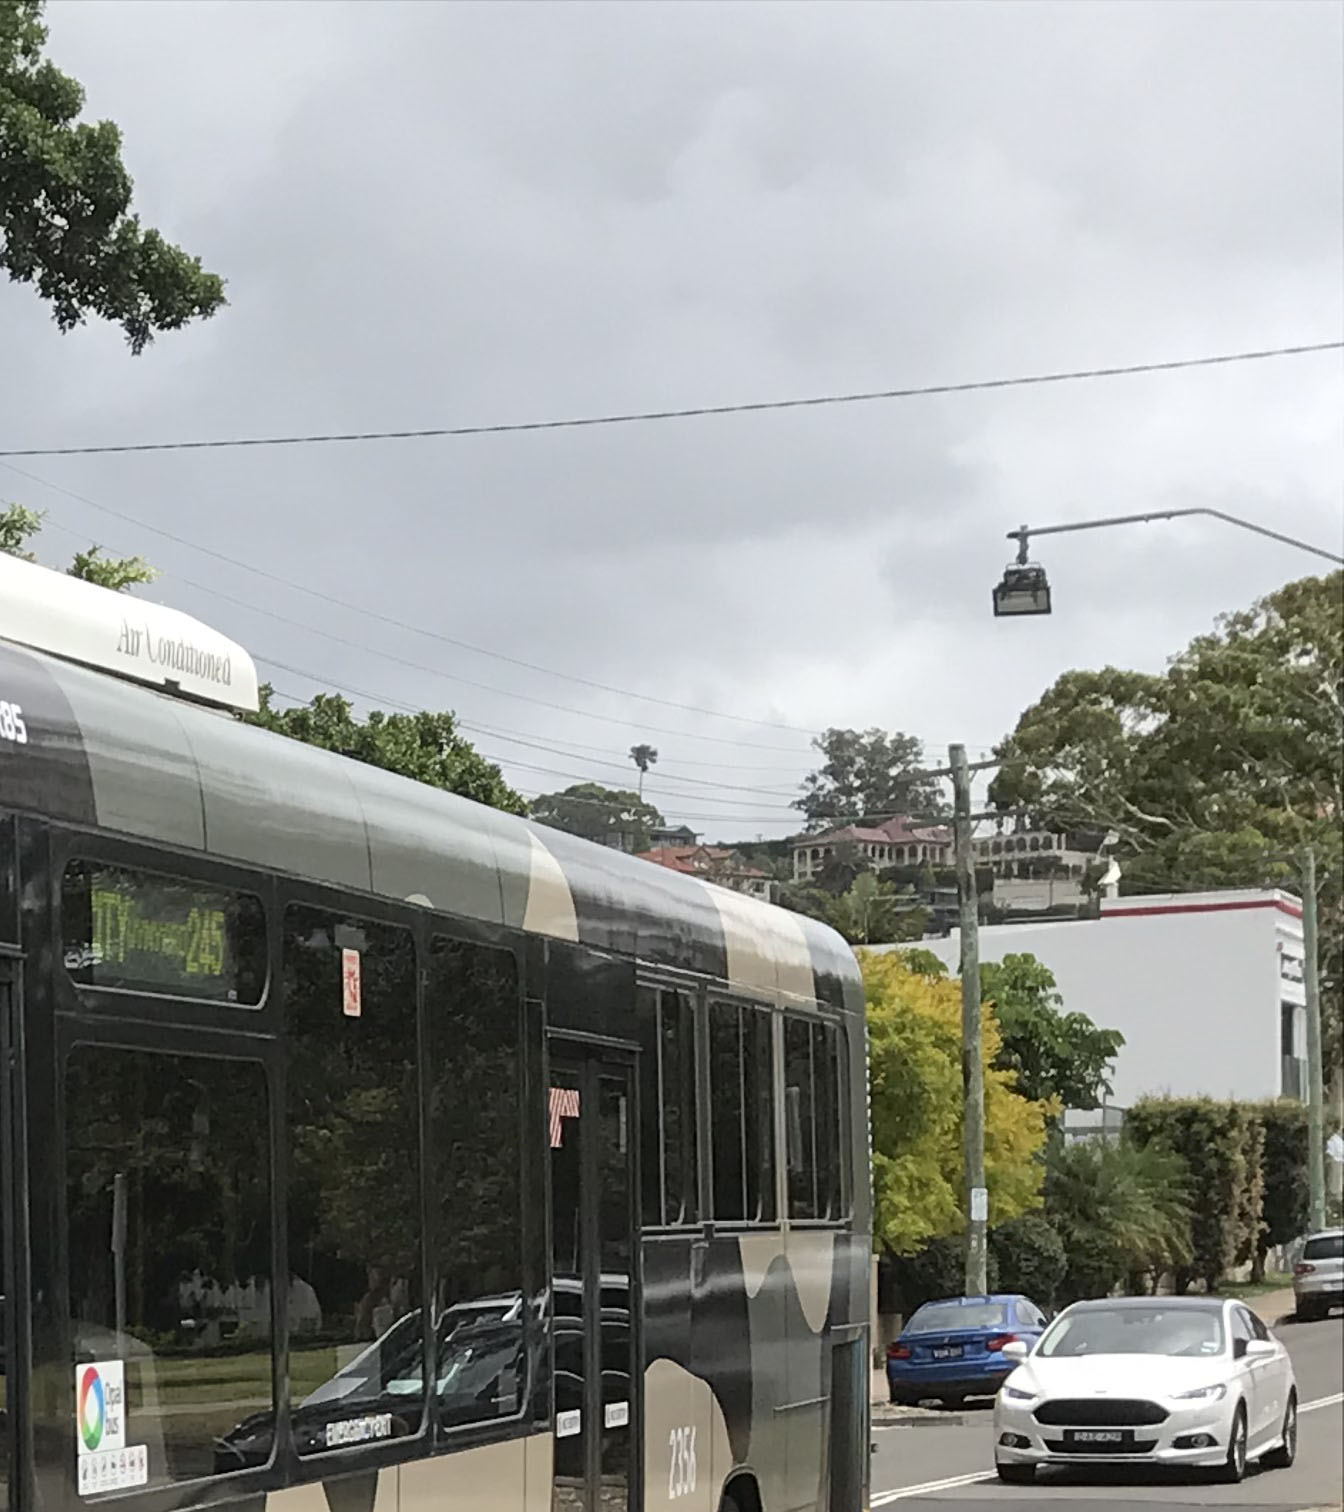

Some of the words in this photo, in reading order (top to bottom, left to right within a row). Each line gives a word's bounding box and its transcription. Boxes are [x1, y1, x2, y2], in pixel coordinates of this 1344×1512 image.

[116, 616, 142, 657] Air
[145, 622, 231, 686] Conditioned
[668, 1426, 697, 1500] 2356
